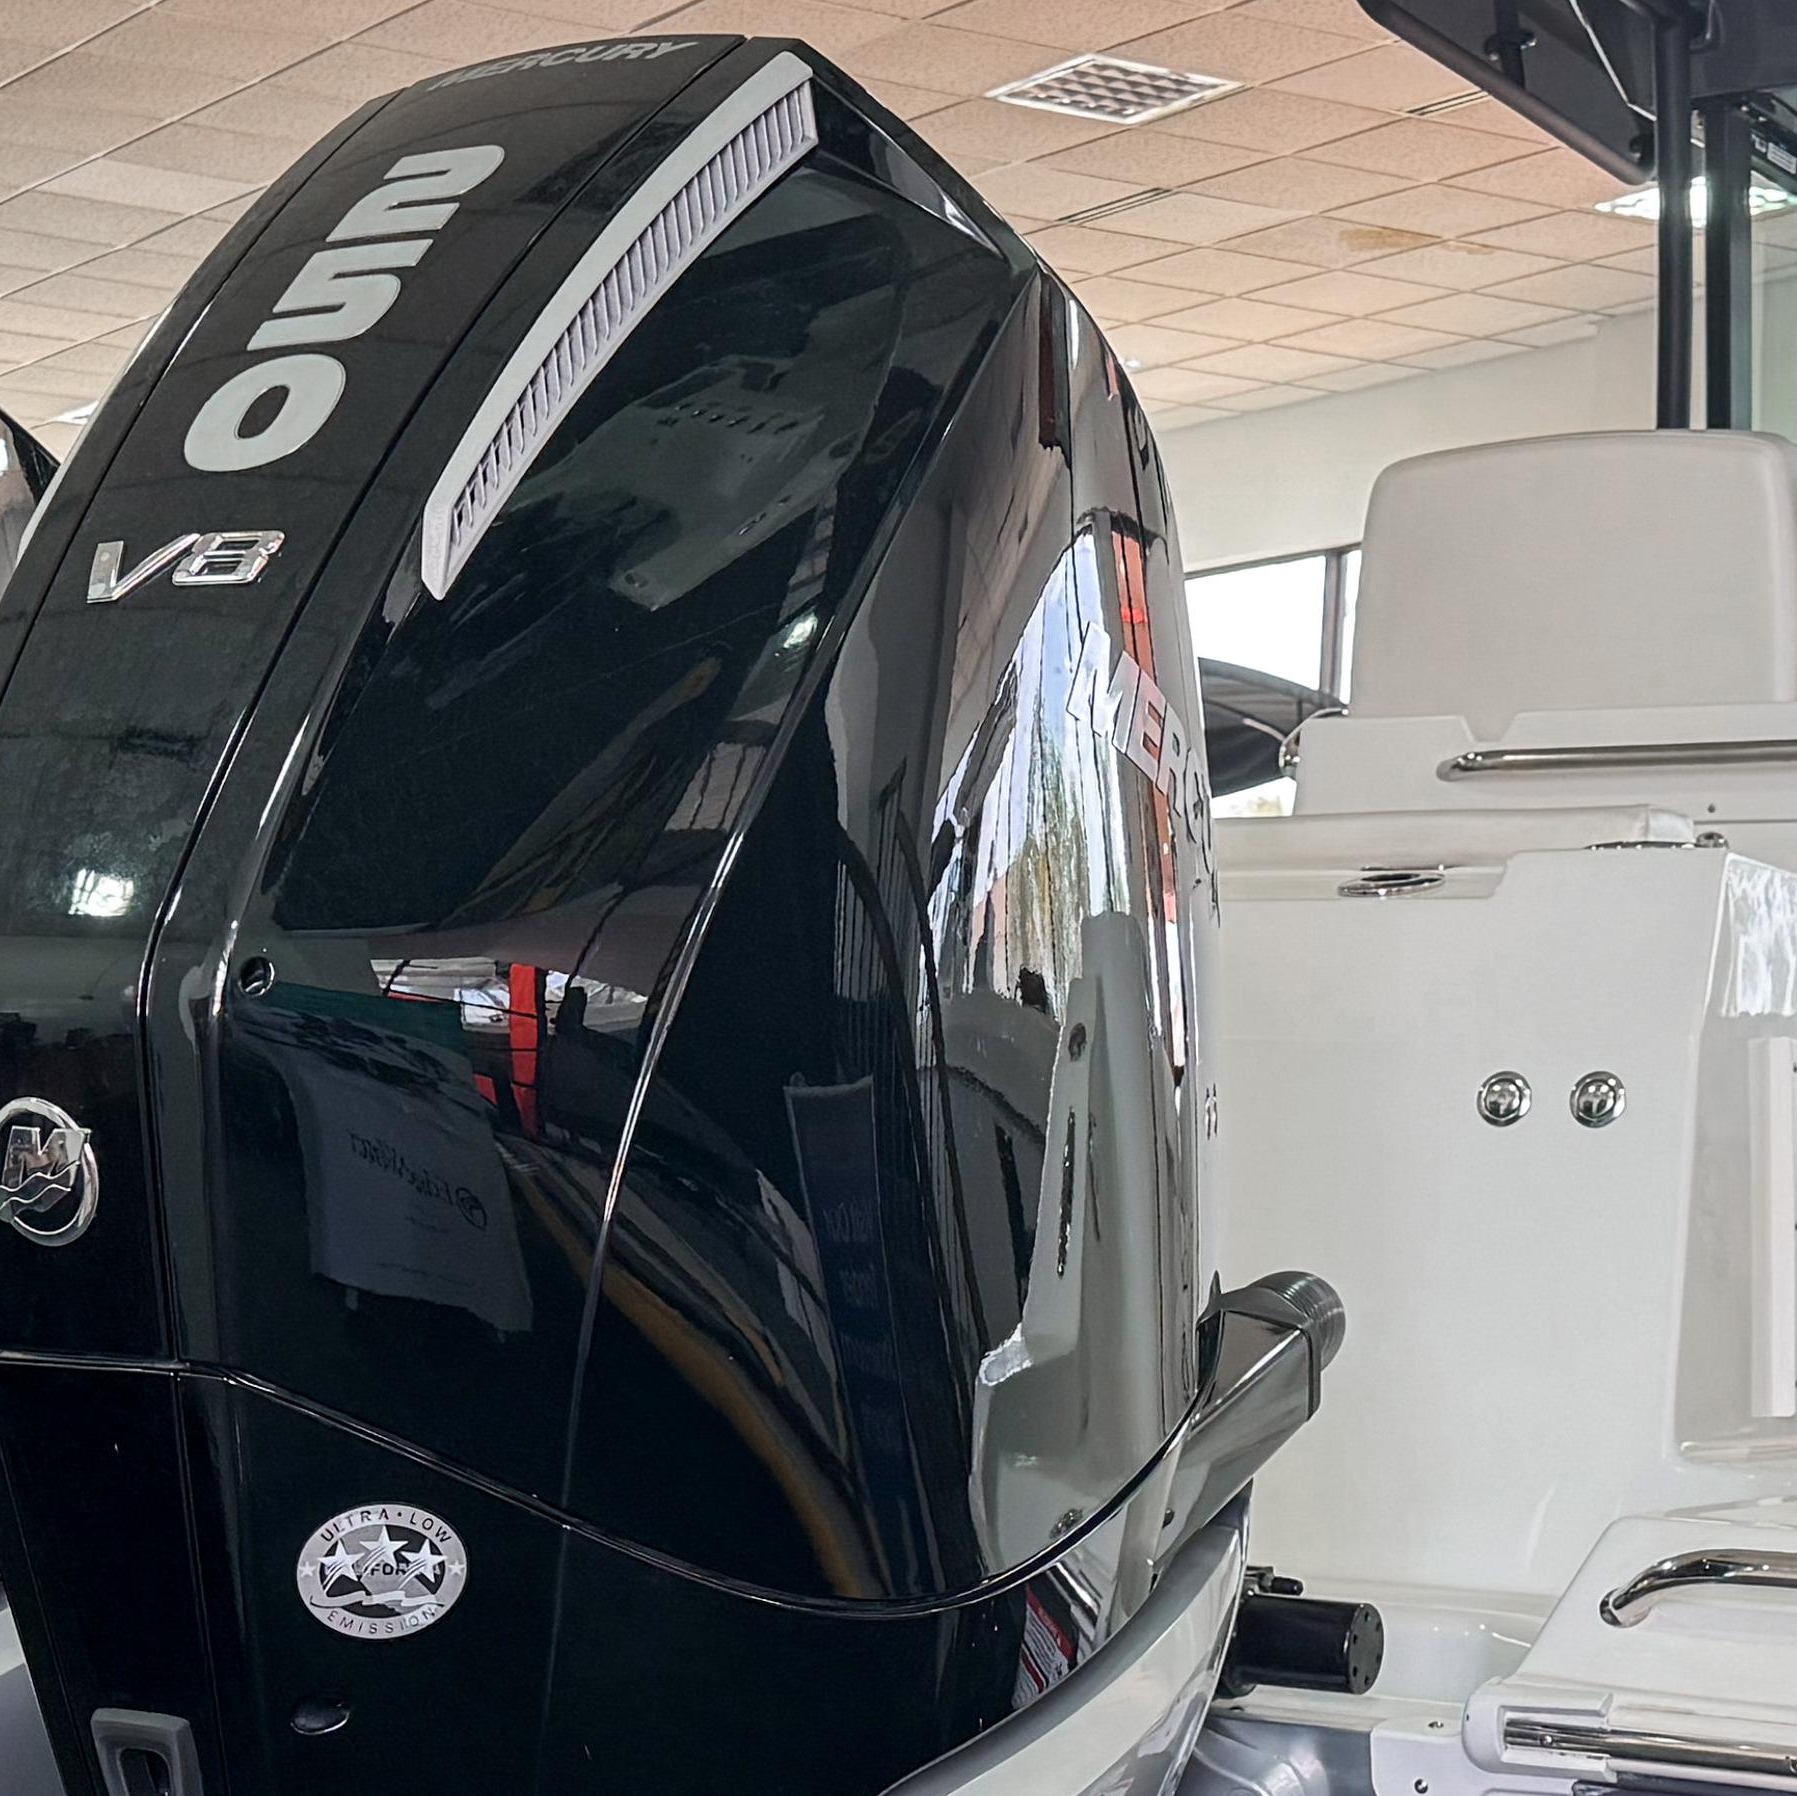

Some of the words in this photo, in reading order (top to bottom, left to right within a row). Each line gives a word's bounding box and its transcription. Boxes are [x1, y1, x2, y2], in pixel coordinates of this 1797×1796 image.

[426, 41, 698, 92] MERCURY
[184, 144, 504, 472] 250
[87, 530, 286, 603] V8
[320, 1508, 390, 1543] ULTRA
[409, 1512, 452, 1544] LOW
[326, 1606, 437, 1635] EMISSION
